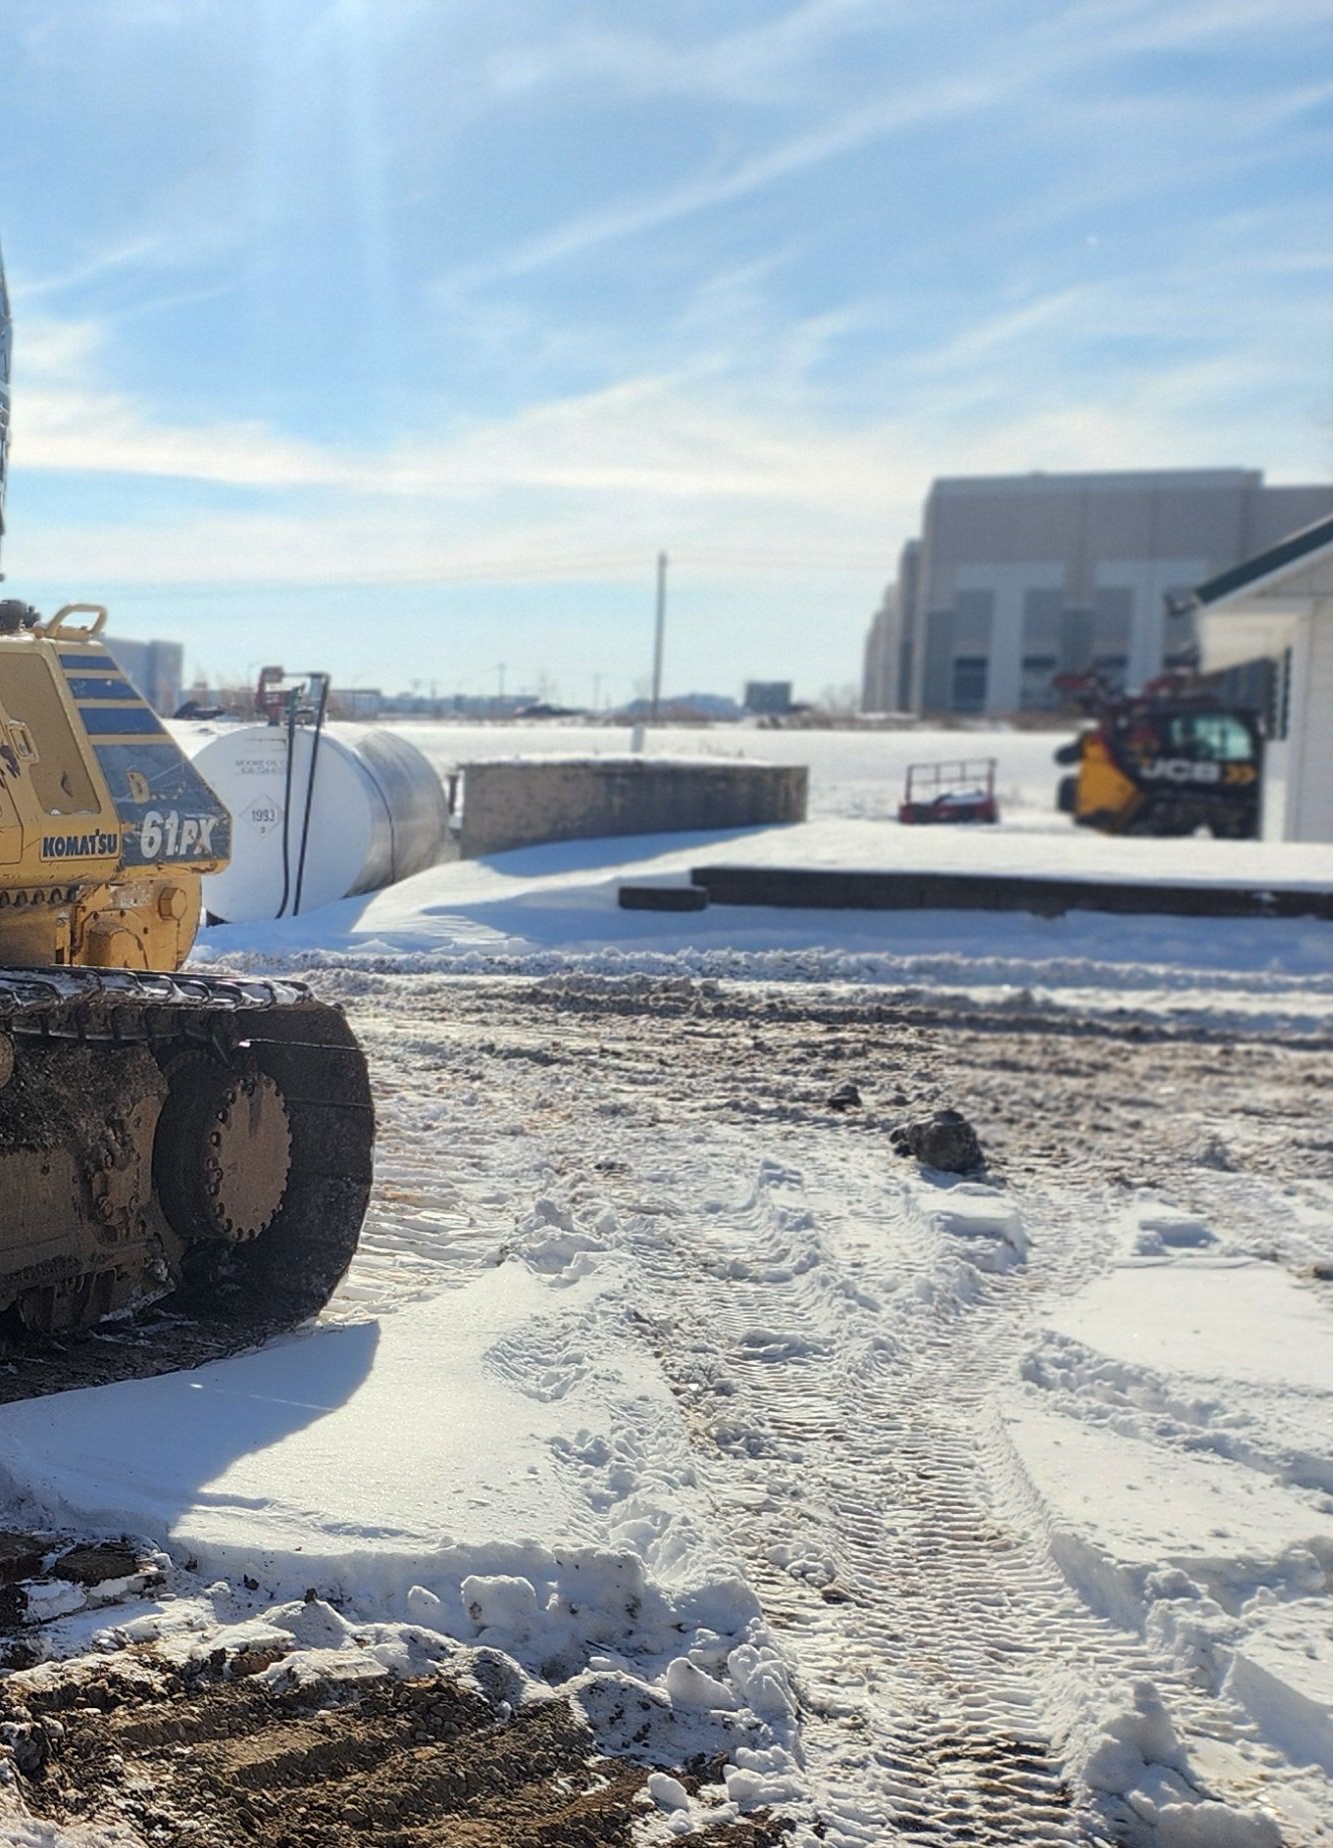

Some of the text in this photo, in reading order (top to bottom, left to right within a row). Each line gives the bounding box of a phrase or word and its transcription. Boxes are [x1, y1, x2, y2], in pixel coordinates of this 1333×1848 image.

[1139, 758, 1220, 783] JCB
[251, 809, 275, 822] 1993
[42, 828, 118, 858] KOMATSU
